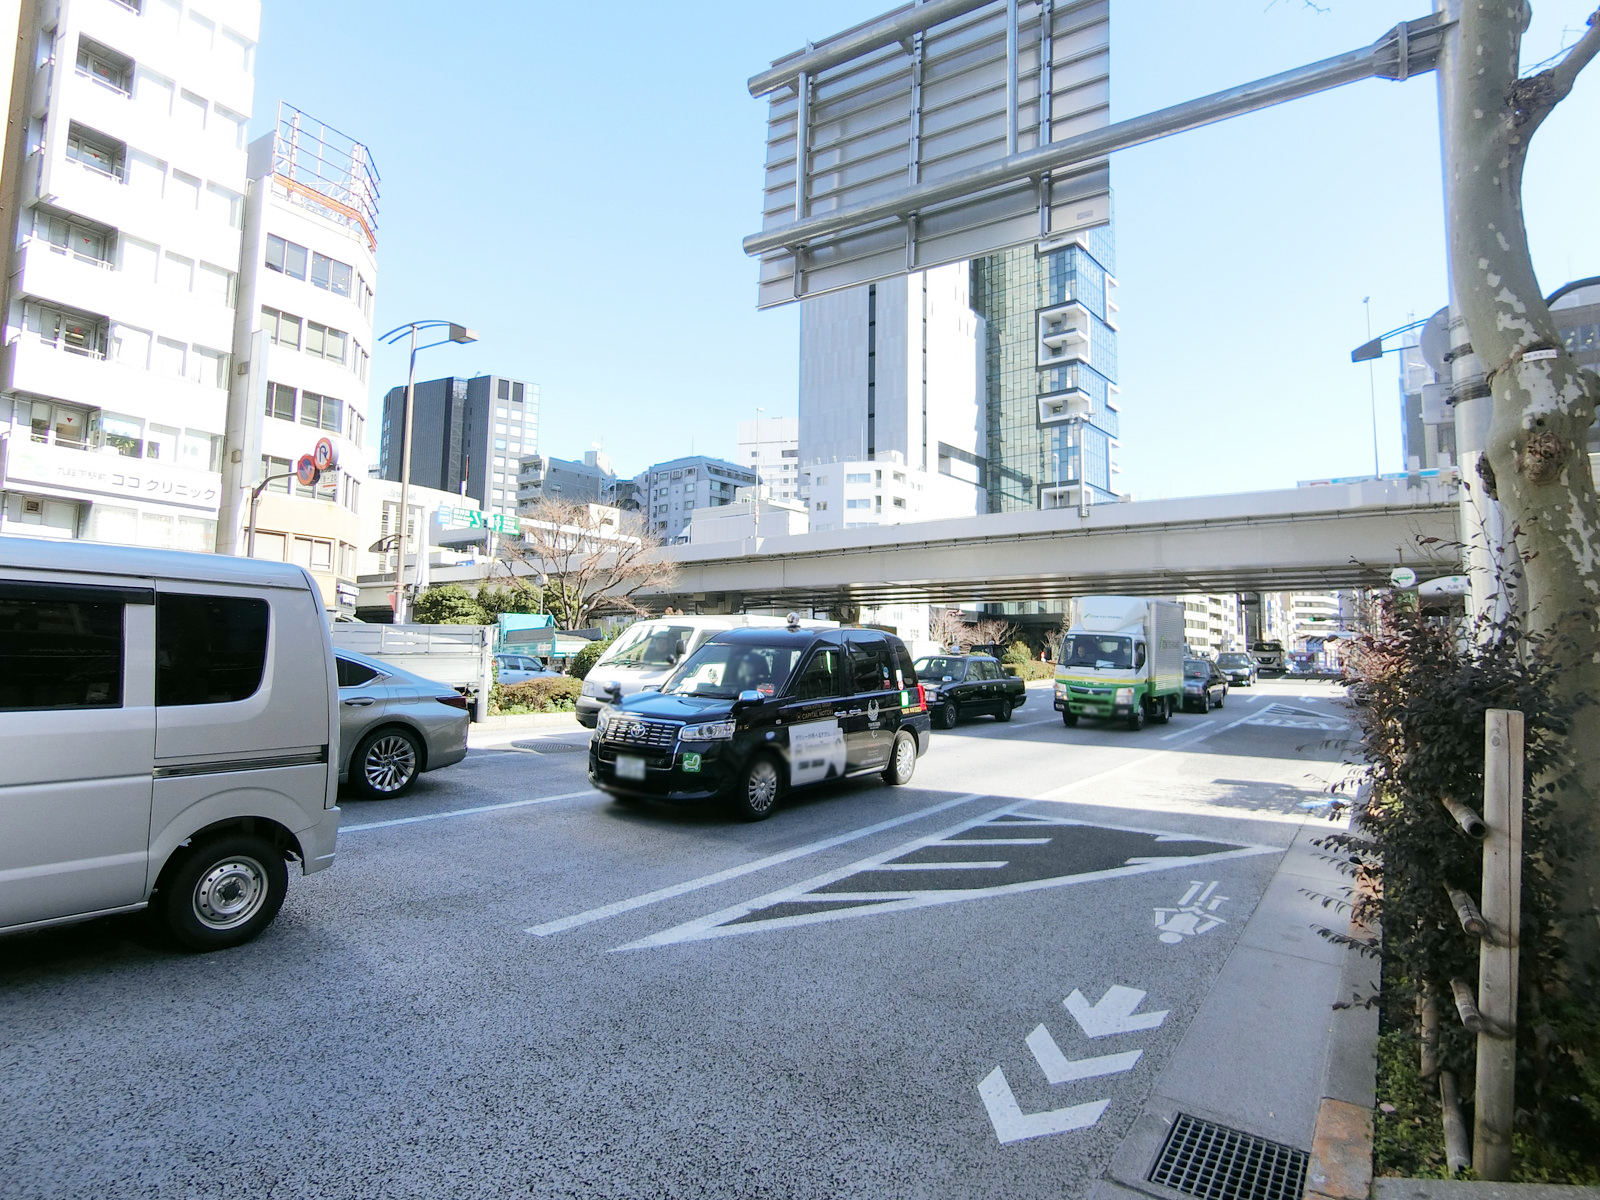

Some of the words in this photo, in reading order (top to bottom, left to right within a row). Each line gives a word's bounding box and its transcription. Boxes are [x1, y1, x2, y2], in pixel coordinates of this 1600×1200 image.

[56, 467, 107, 483] 九段下駅前
[111, 473, 140, 488] ココ
[146, 479, 216, 500] クリニック
